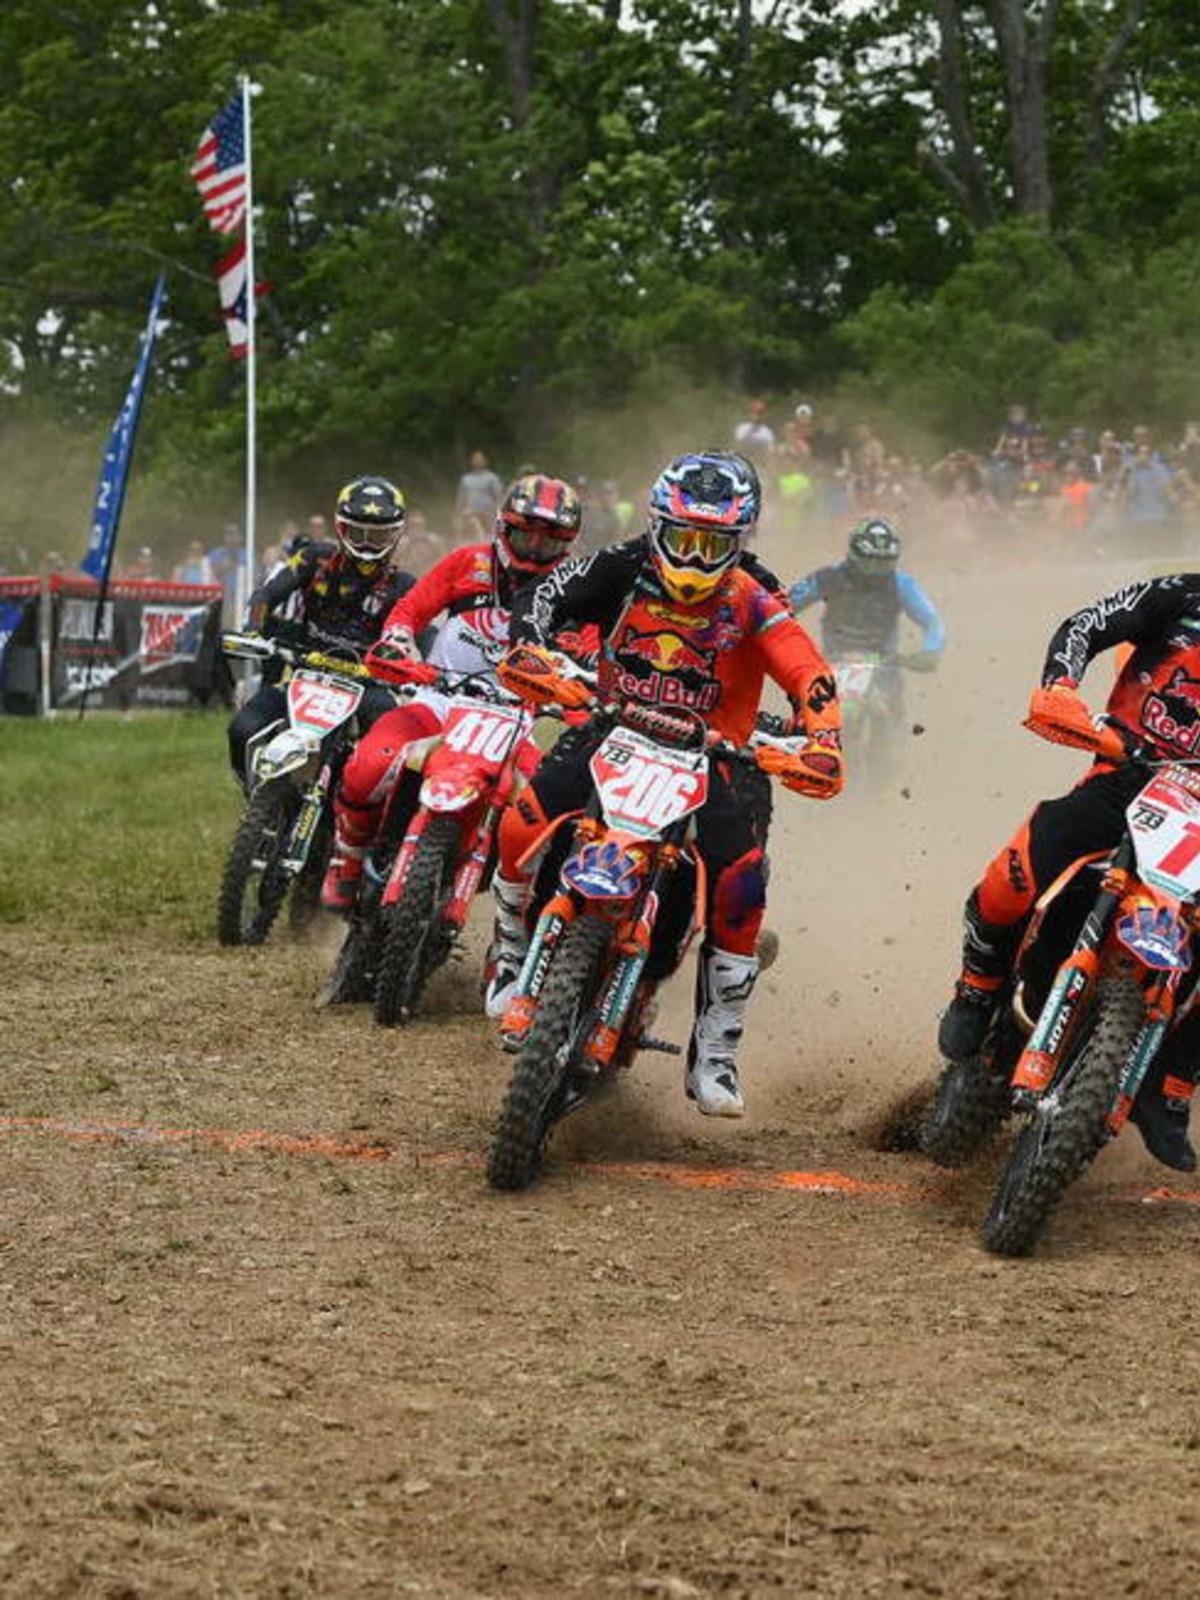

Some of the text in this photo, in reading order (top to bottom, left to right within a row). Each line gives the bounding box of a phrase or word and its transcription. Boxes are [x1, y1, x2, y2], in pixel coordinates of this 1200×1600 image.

[660, 676, 720, 711] Bull
[445, 709, 520, 763] 410
[601, 762, 698, 827] 206
